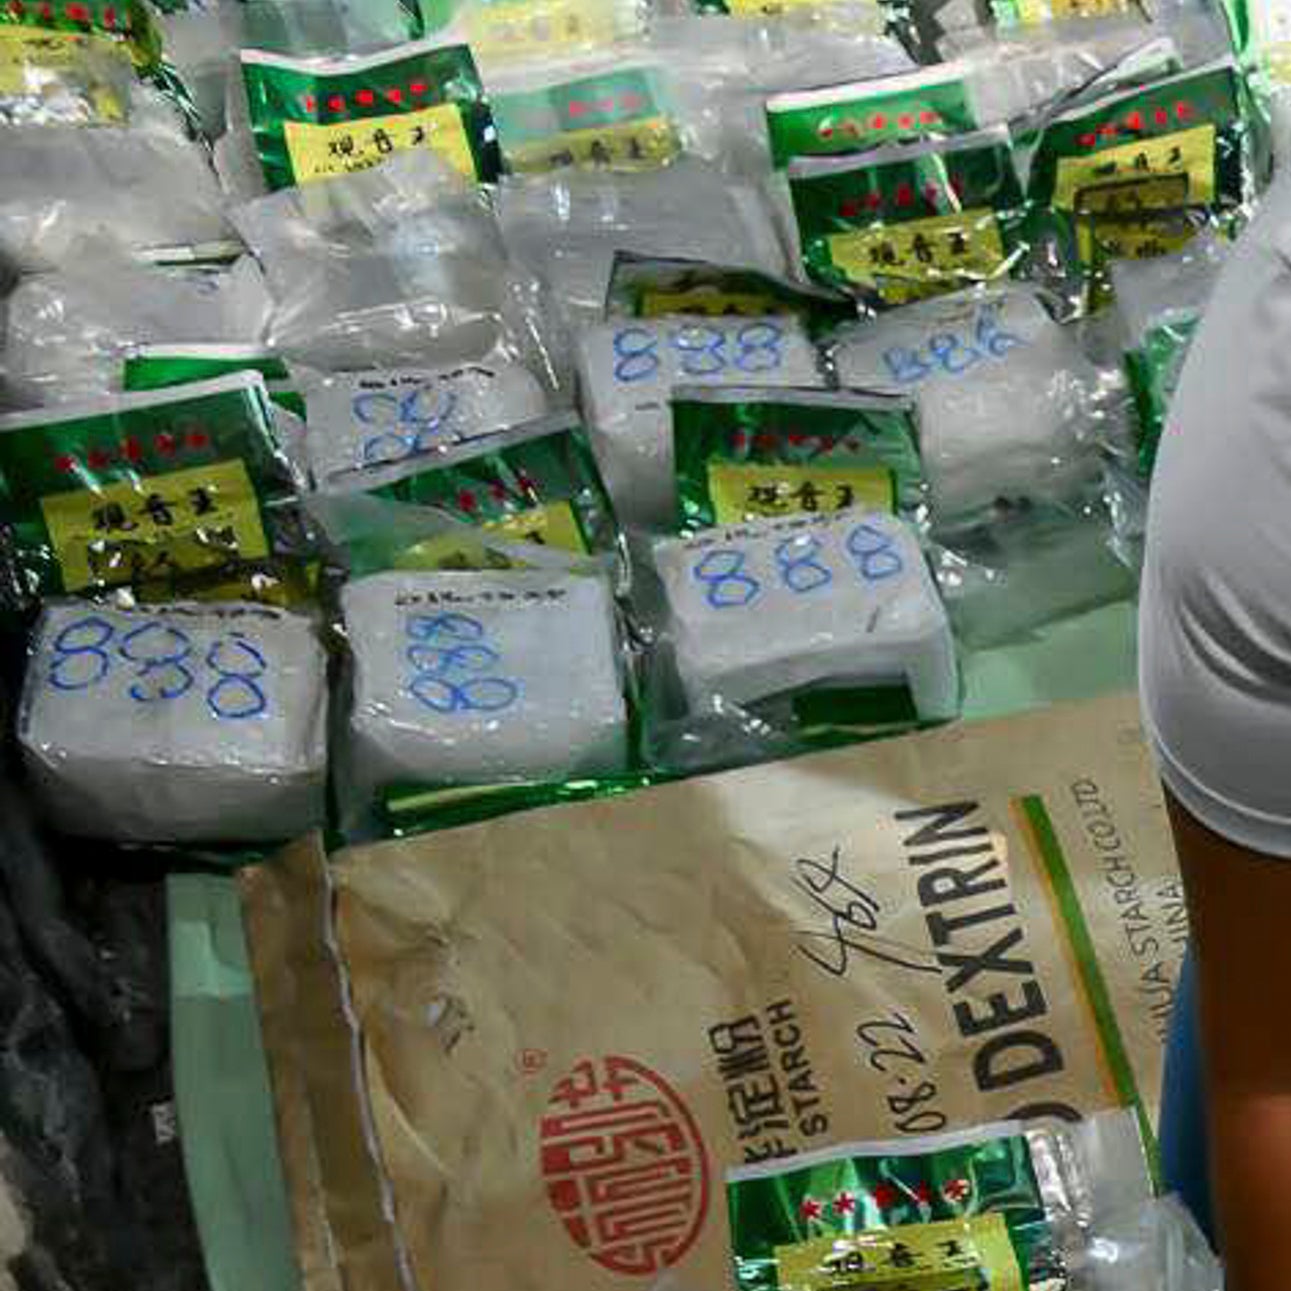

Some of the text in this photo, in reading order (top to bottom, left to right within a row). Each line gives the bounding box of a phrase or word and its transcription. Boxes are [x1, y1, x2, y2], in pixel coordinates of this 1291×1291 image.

[693, 524, 903, 610] 888
[48, 616, 267, 719] 888
[892, 796, 1068, 1096] DEXTRIN
[766, 998, 830, 1138] STARCH
